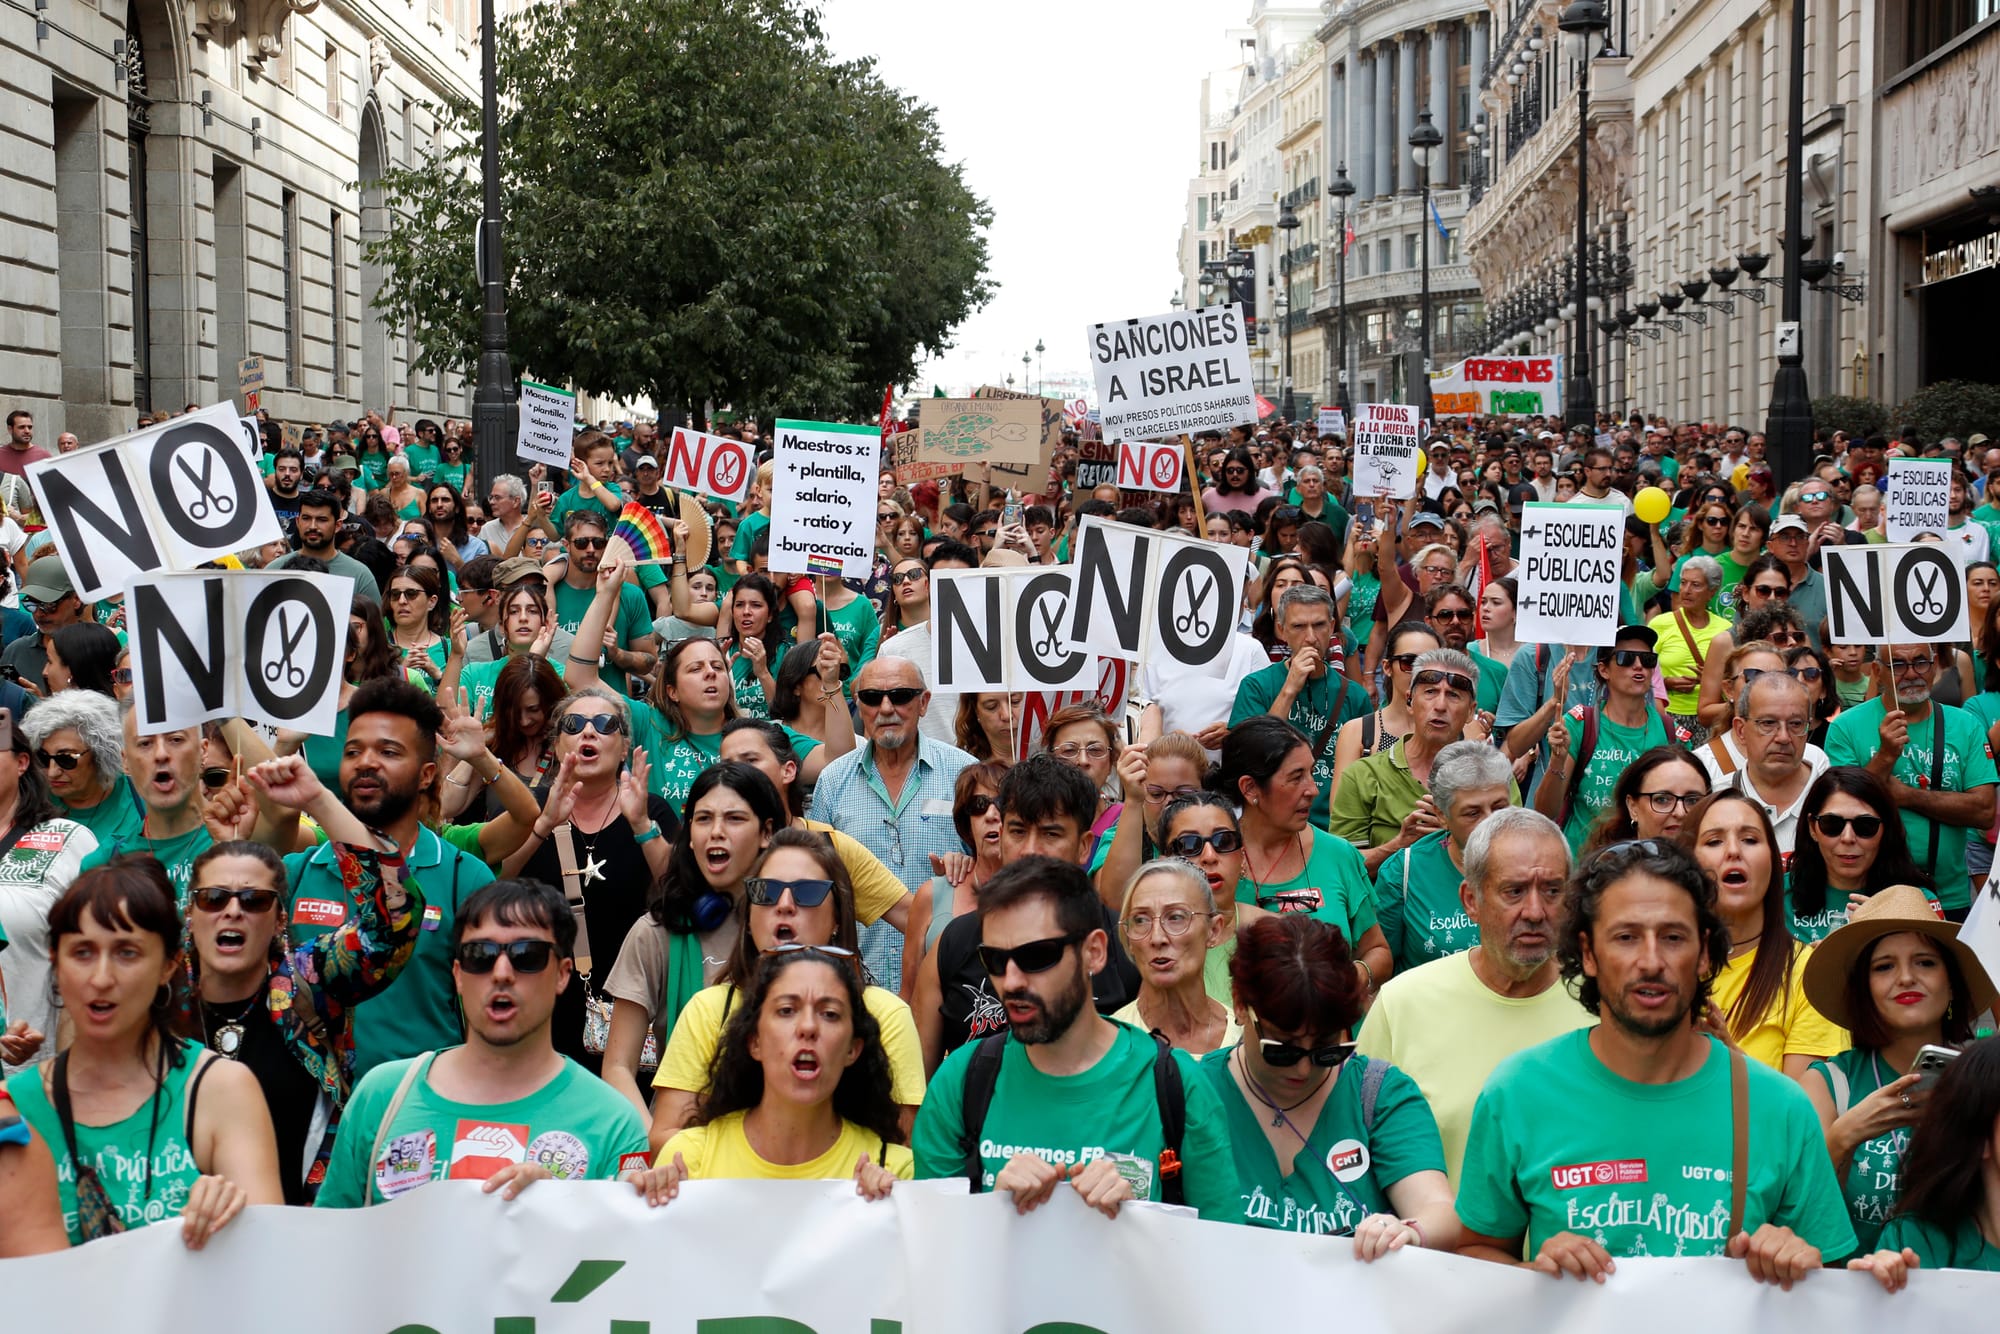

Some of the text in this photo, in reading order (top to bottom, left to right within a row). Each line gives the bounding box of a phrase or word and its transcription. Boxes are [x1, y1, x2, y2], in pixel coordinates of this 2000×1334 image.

[1095, 312, 1238, 364] SANCIONES
[1108, 358, 1240, 403] A ISRAEL
[525, 388, 569, 408] Maestros x:
[533, 405, 567, 420] plantilla,
[1063, 399, 1087, 418] NO
[1105, 395, 1250, 426] MOV. PRESOS POLÍTICOS SAHARAUIS
[1368, 405, 1408, 422] TODAS
[531, 418, 559, 431] salario,
[1124, 427, 1135, 438] EN
[1137, 420, 1179, 436] CARCELES
[1359, 422, 1366, 432] A
[1369, 422, 1379, 433] LA
[1383, 422, 1416, 435] HUELGA
[533, 431, 552, 442] ratio
[782, 434, 870, 457] Maestros x:
[1357, 433, 1416, 447] ¡LA LUCHA ES
[521, 438, 567, 458] -burocracia.
[1080, 442, 1115, 461] SIN
[1360, 445, 1412, 459] EL CAMINO!
[667, 431, 747, 495] NO
[788, 462, 865, 484] + plantilla,
[1118, 444, 1179, 489] NO
[1890, 471, 1948, 486] + ESCUELAS
[795, 487, 851, 508] salario,
[1892, 488, 1947, 506] PÚBLICAS
[37, 422, 257, 593] NO
[803, 514, 839, 529] ratio
[843, 521, 852, 534] y
[1888, 512, 1946, 528] + EQUIPADAS!
[1523, 523, 1616, 549] + ESCUELAS
[776, 536, 867, 558] -burocracia.
[1527, 552, 1615, 584] PÚBLICAS
[1071, 526, 1234, 665] NO
[1827, 547, 1961, 637] NO
[1519, 592, 1614, 619] + EQUIPADAS!
[937, 573, 1087, 685] NO
[134, 578, 336, 724] NO
[677, 770, 696, 779] DE
[1596, 775, 1613, 786] DE
[20, 834, 61, 844] CCOO
[298, 901, 343, 914] CCOO
[981, 1139, 1075, 1164] Queremos
[1335, 1153, 1360, 1167] CNT
[1553, 1166, 1593, 1187] UGT
[1682, 1166, 1713, 1180] UGT
[1568, 1198, 1662, 1231] ESCUELA
